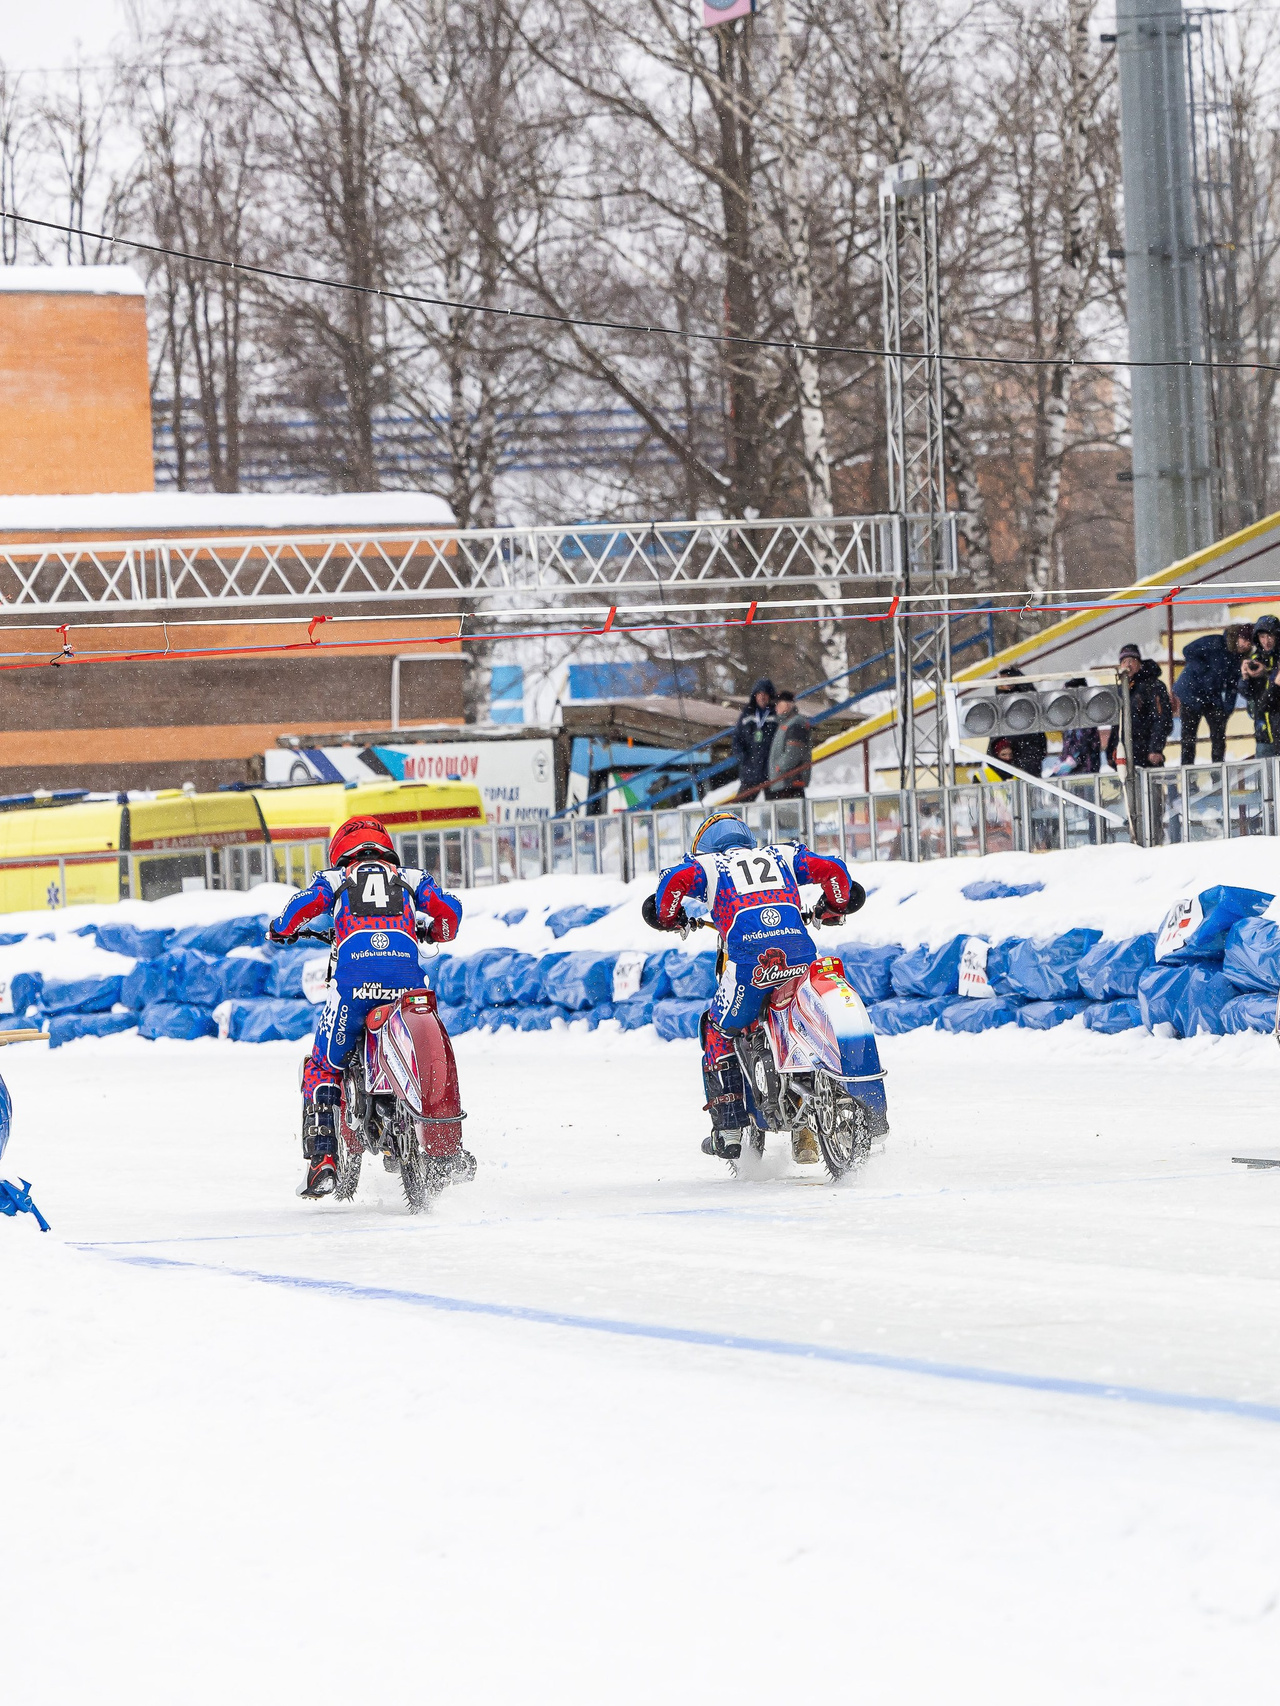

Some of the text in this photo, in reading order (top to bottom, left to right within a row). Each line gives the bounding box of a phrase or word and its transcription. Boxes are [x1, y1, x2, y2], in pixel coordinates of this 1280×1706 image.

[736, 857, 777, 886] 12
[362, 873, 389, 908] 4
[753, 964, 808, 984] Kononov
